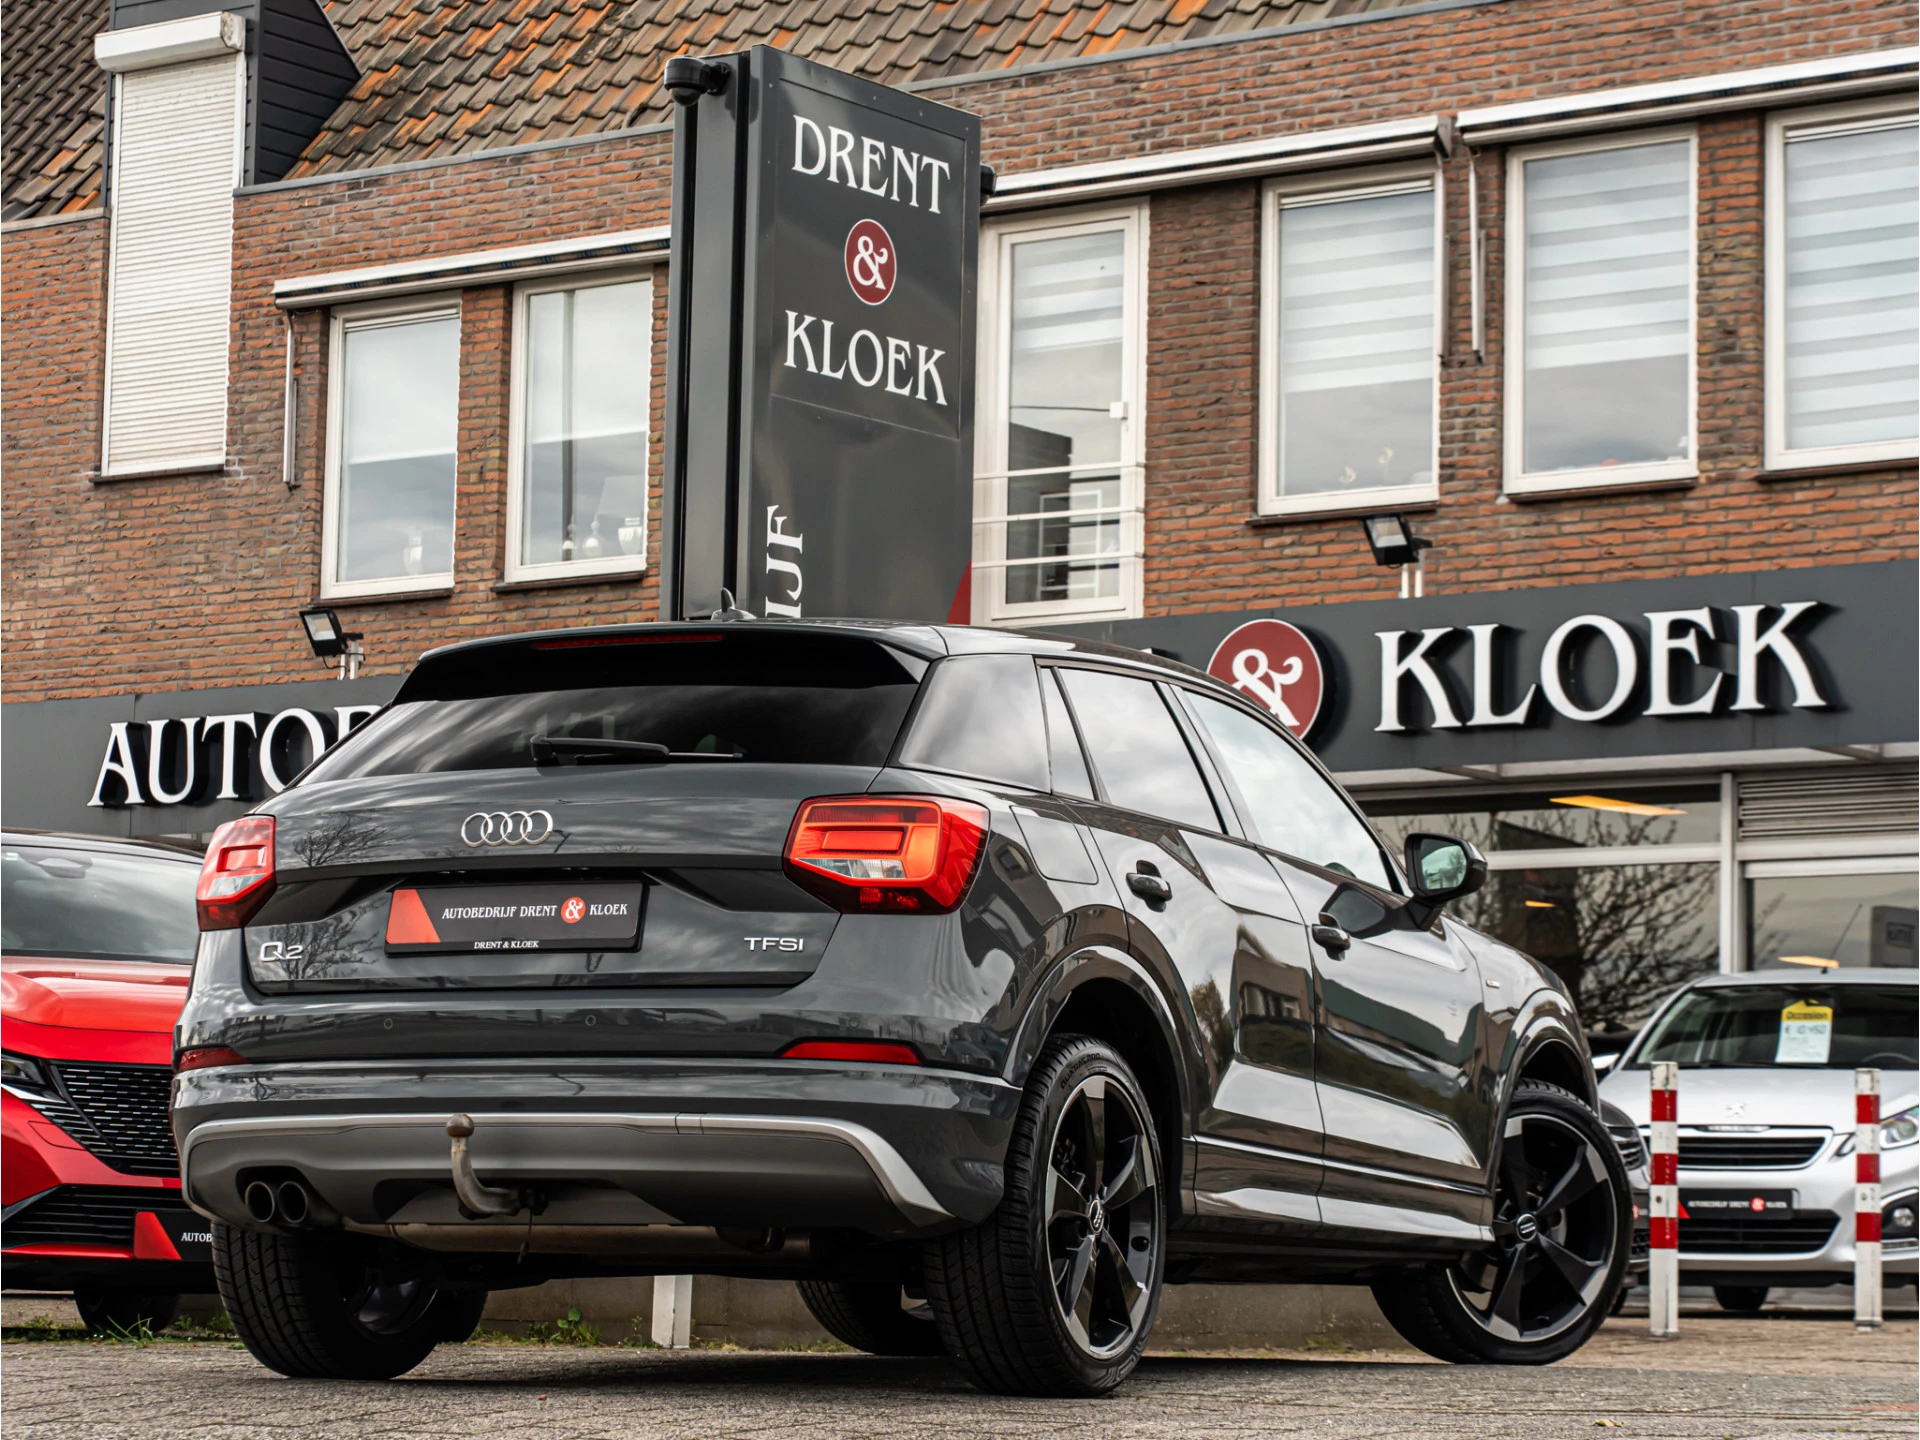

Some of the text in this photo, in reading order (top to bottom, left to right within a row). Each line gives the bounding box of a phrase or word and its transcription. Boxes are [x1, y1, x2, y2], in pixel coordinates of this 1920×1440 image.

[792, 114, 950, 214] DRENT
[853, 234, 889, 290] &
[783, 309, 948, 406] KLOEK
[1373, 600, 1827, 733] KLOEK
[441, 899, 629, 920] AUTOBEDRIJF DRENT & KLOEK
[260, 941, 303, 961] Q2
[473, 940, 502, 950] DRENT
[510, 940, 540, 949] KLOEK
[743, 937, 804, 951] TFSI
